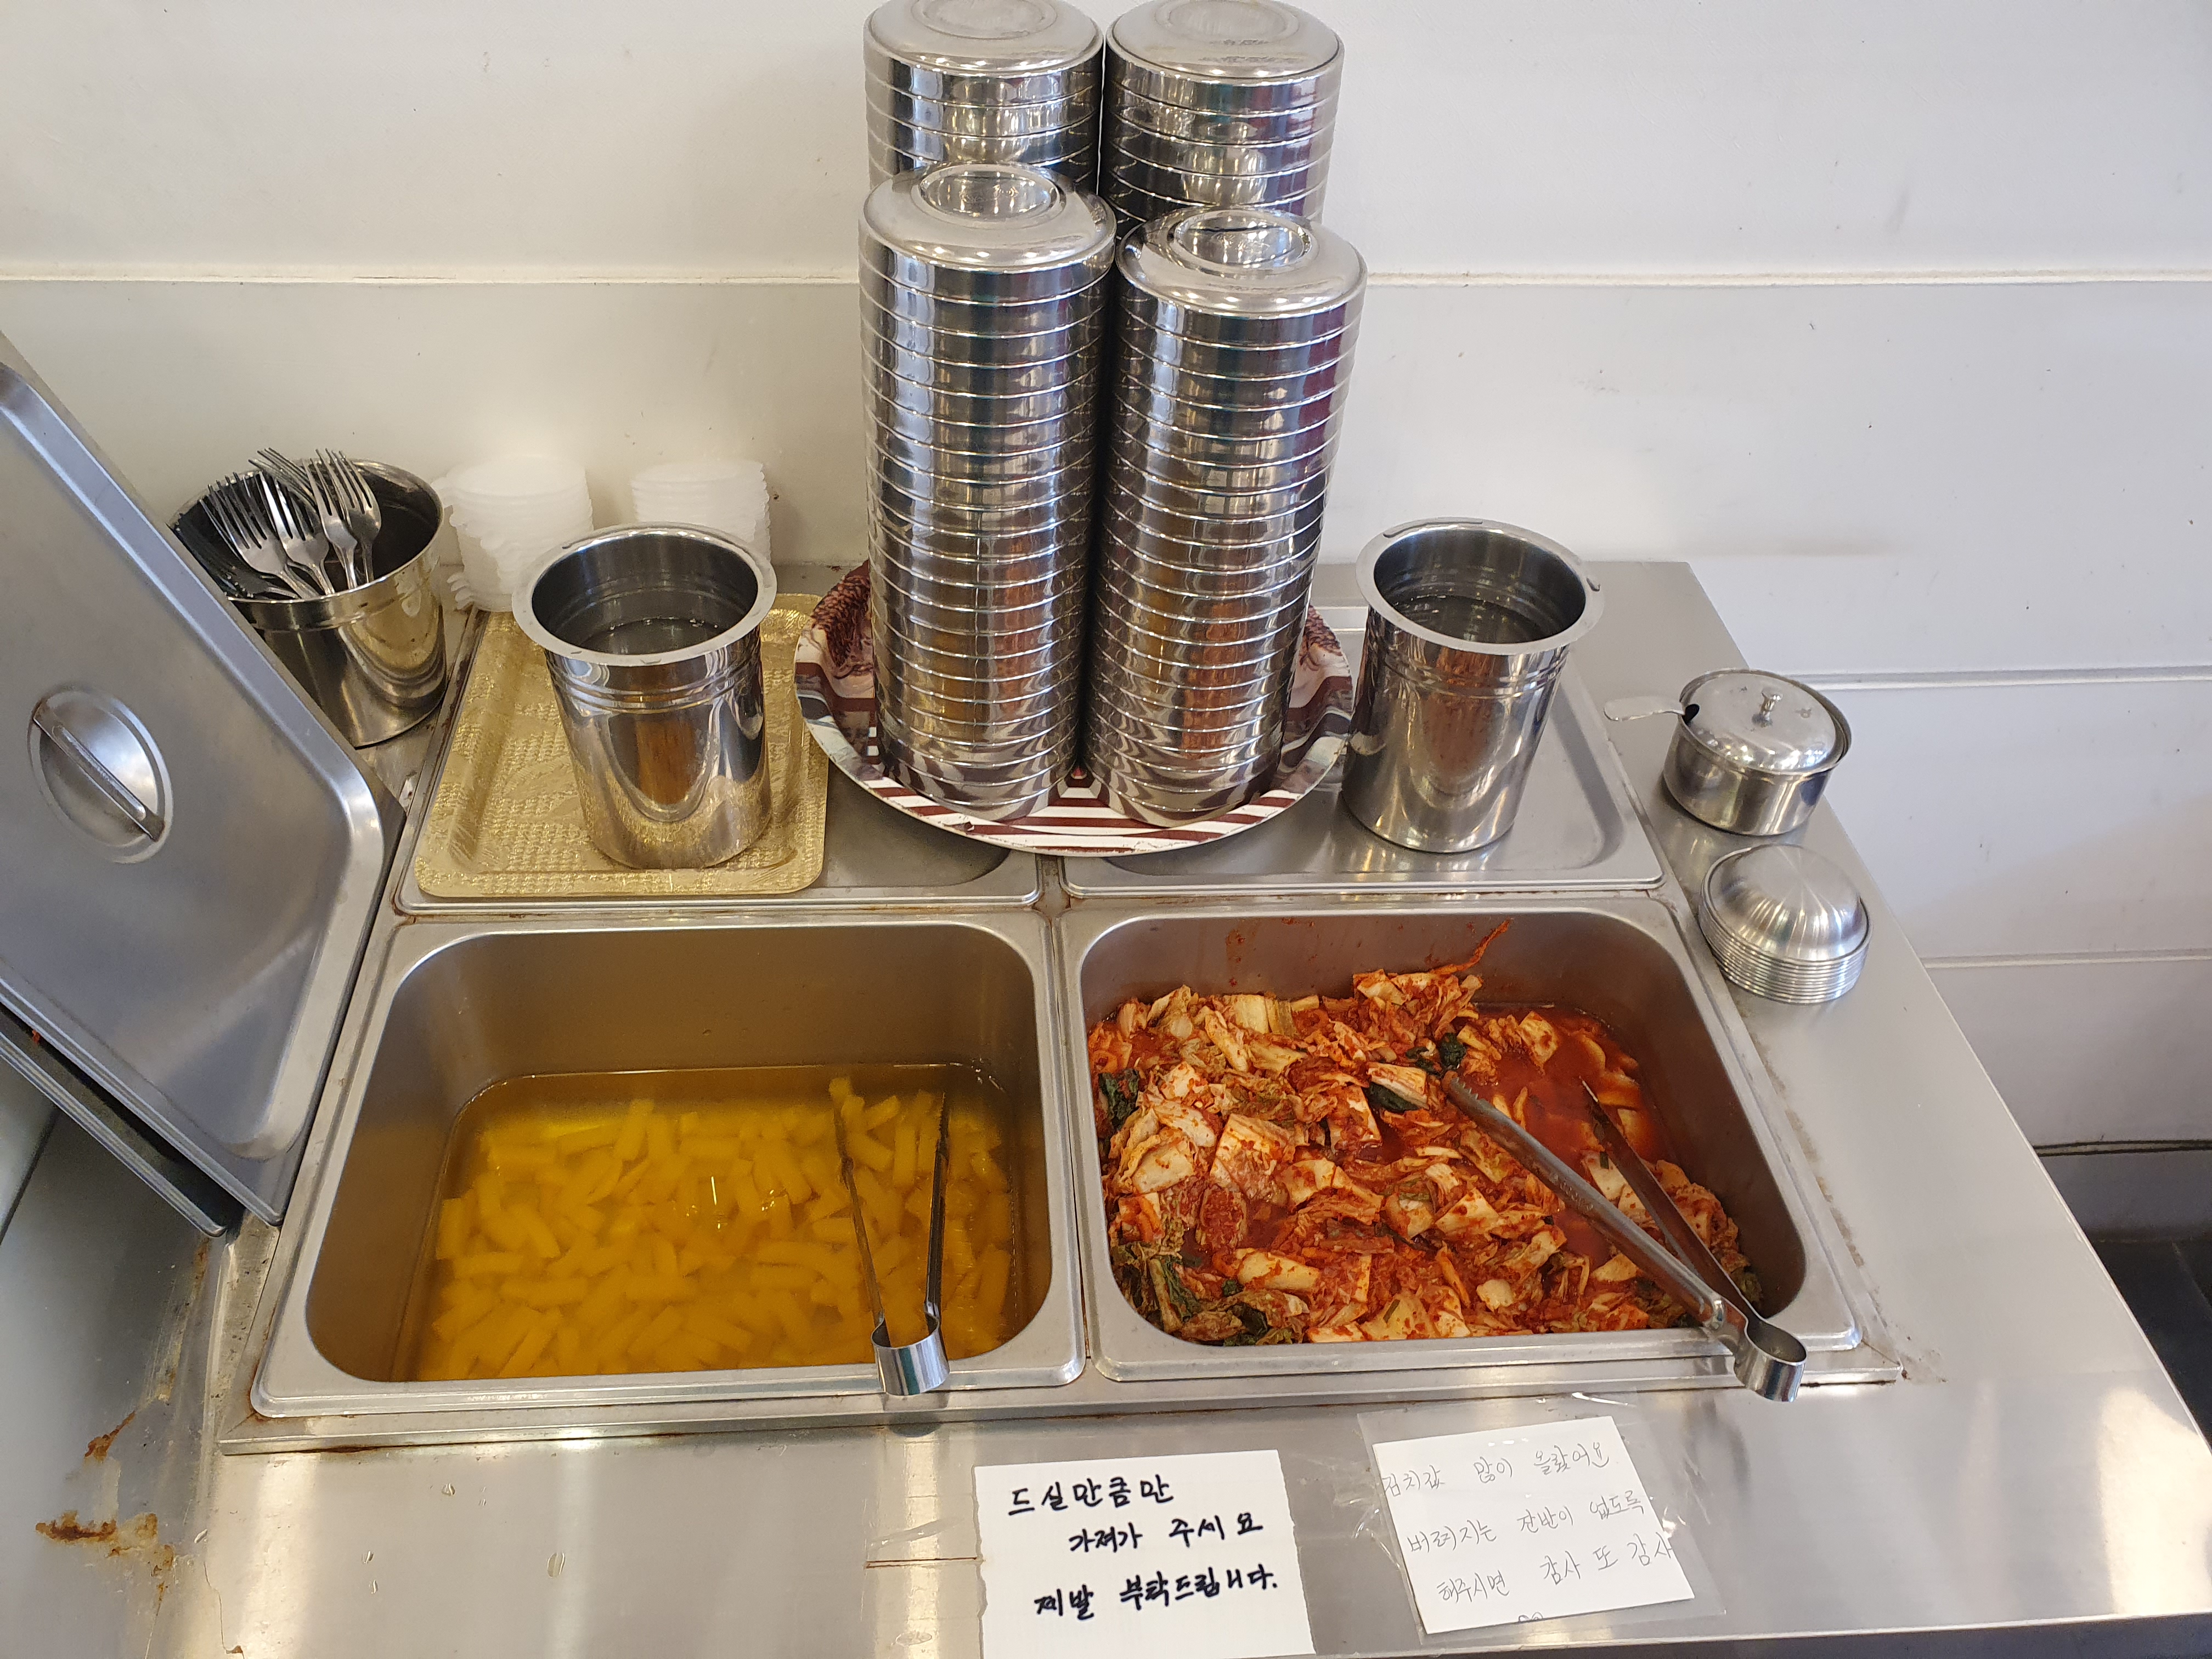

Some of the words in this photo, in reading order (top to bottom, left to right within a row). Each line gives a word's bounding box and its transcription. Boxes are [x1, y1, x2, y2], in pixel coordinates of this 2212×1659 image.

[1008, 1474, 1174, 1516] 드실만큼만
[1383, 1464, 1445, 1497] 김치값
[1473, 1456, 1513, 1484] 많이
[1533, 1442, 1610, 1476] 올랐어요
[1068, 1521, 1143, 1553] 가져가
[1407, 1519, 1497, 1553] 버려지는
[1516, 1506, 1573, 1533] 잔반이
[1589, 1489, 1644, 1520] 없도록
[1034, 1584, 1095, 1621] 제발
[1119, 1563, 1278, 1611] 부탁드립니다.
[1436, 1570, 1510, 1604] 해주시면
[1539, 1550, 1581, 1585] 감사
[1592, 1545, 1618, 1571] 또
[1627, 1532, 1672, 1567] 감사
